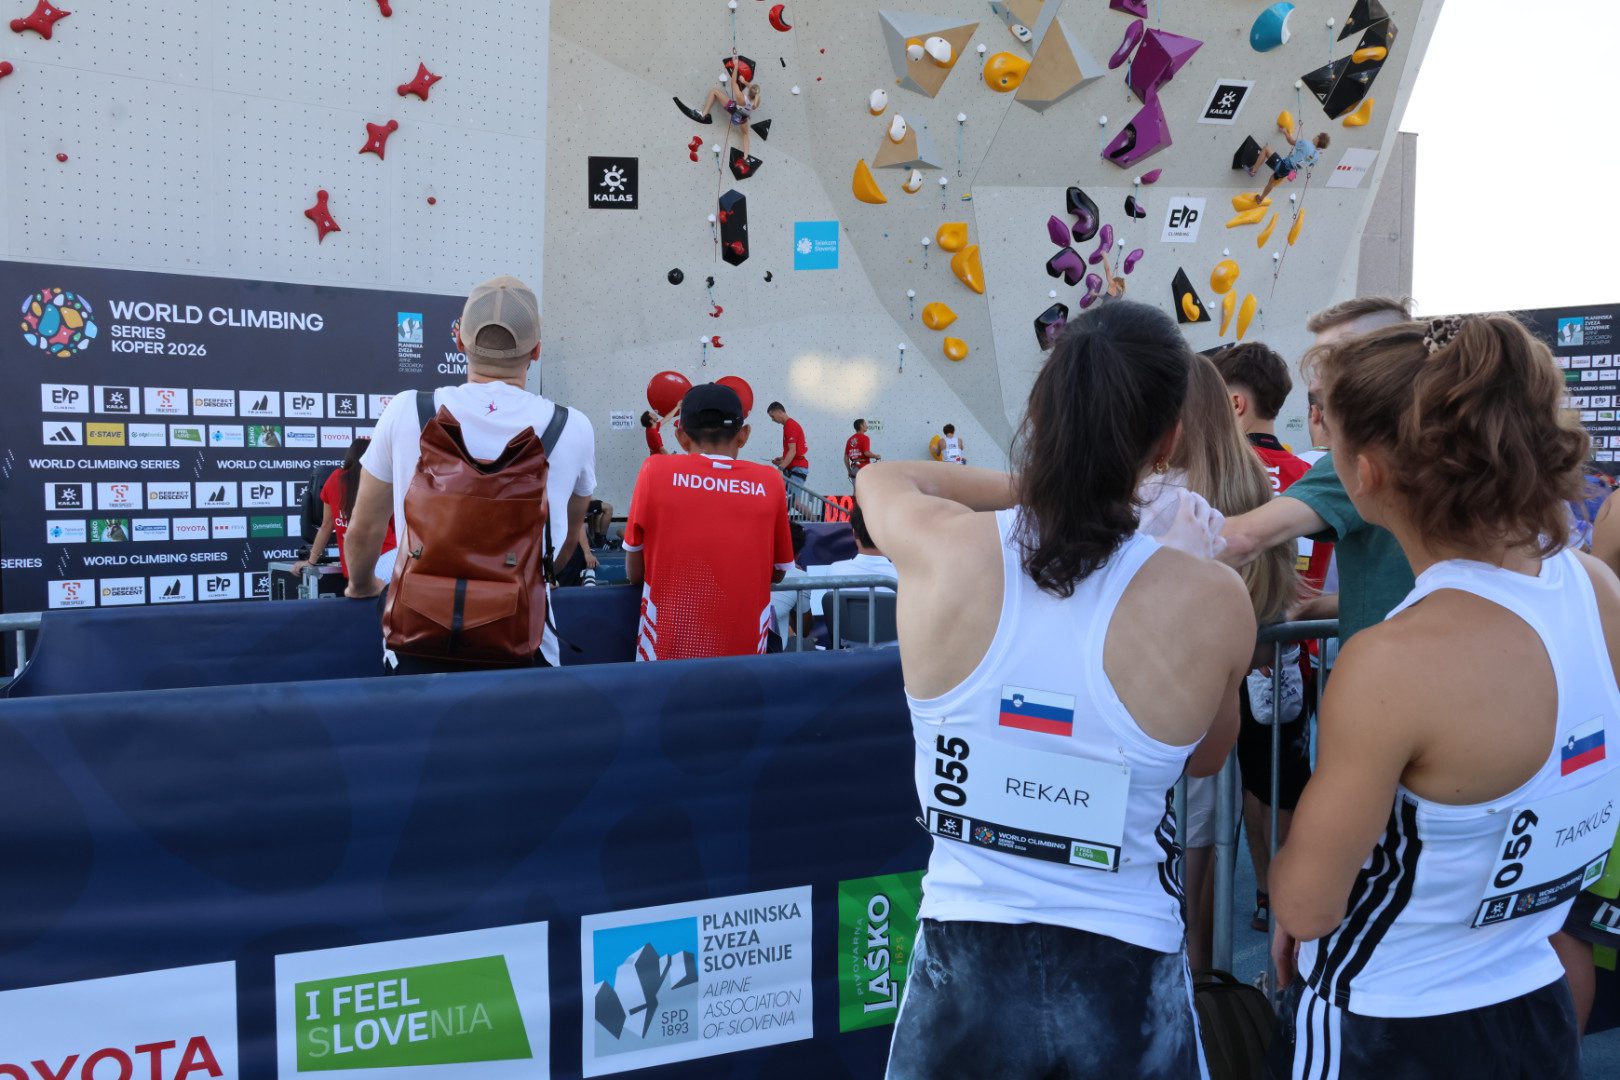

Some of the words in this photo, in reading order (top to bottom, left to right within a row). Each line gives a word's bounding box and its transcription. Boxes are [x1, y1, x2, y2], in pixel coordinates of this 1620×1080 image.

[594, 194, 633, 202] KAILAS
[109, 300, 202, 324] WORLD
[208, 307, 324, 331] CLIMBING
[111, 325, 166, 340] SERIES
[112, 340, 164, 355] KOPER
[168, 343, 207, 357] 2026
[438, 364, 467, 374] CLIM
[29, 459, 76, 469] WORLD
[77, 459, 138, 469] CLIMBING
[140, 459, 180, 469] SERIES
[217, 460, 257, 469] WORLD
[259, 460, 311, 469] CLIMBING
[673, 472, 766, 497] INDONESIA
[0, 558, 43, 569] SERIES
[83, 555, 128, 566] WORLD
[130, 554, 188, 564] CLIMBING
[190, 552, 228, 562] SERIES
[934, 734, 970, 807] 055
[1005, 778, 1090, 808] REKAR
[1555, 800, 1614, 848] TARKUŠ
[999, 832, 1027, 843] WORLD
[1028, 839, 1066, 850] CLIMBING
[1493, 809, 1539, 889] 059
[703, 902, 802, 931] PLANINSKA
[1590, 902, 1620, 929] IT
[703, 930, 760, 953] ZVEZA
[862, 894, 898, 1015] LAŠKO
[704, 944, 793, 973] SLOVENIJE
[849, 918, 864, 996] PIVOVARNA
[305, 990, 321, 1021] I
[333, 978, 420, 1017] FEEL
[703, 976, 752, 999] ALPINE
[661, 1009, 689, 1025] SPD
[703, 988, 802, 1019] ASSOCIATION
[308, 1002, 493, 1059] SLOVENIA
[661, 1023, 689, 1038] 1893
[703, 1023, 725, 1040] OF
[727, 1011, 795, 1036] SLOVENIA
[0, 1035, 224, 1080] YOTA
